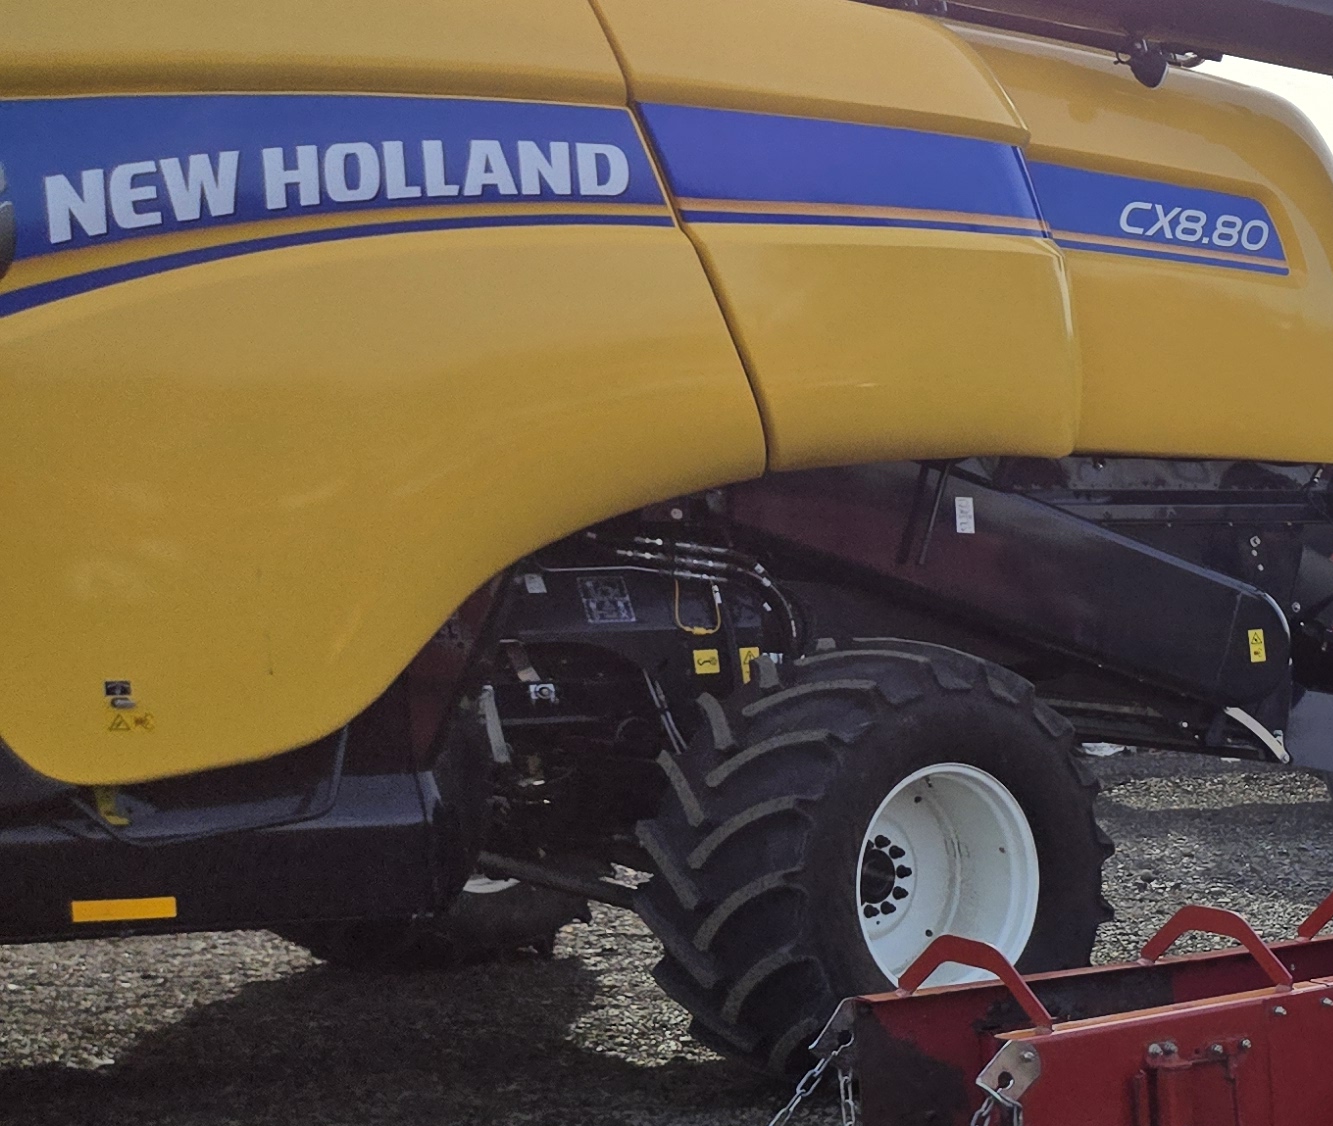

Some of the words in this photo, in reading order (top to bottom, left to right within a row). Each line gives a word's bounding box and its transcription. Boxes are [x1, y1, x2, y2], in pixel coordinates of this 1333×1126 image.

[45, 151, 239, 244] NEW
[262, 140, 629, 210] HOLLAND
[1119, 202, 1269, 251] CX8.80
